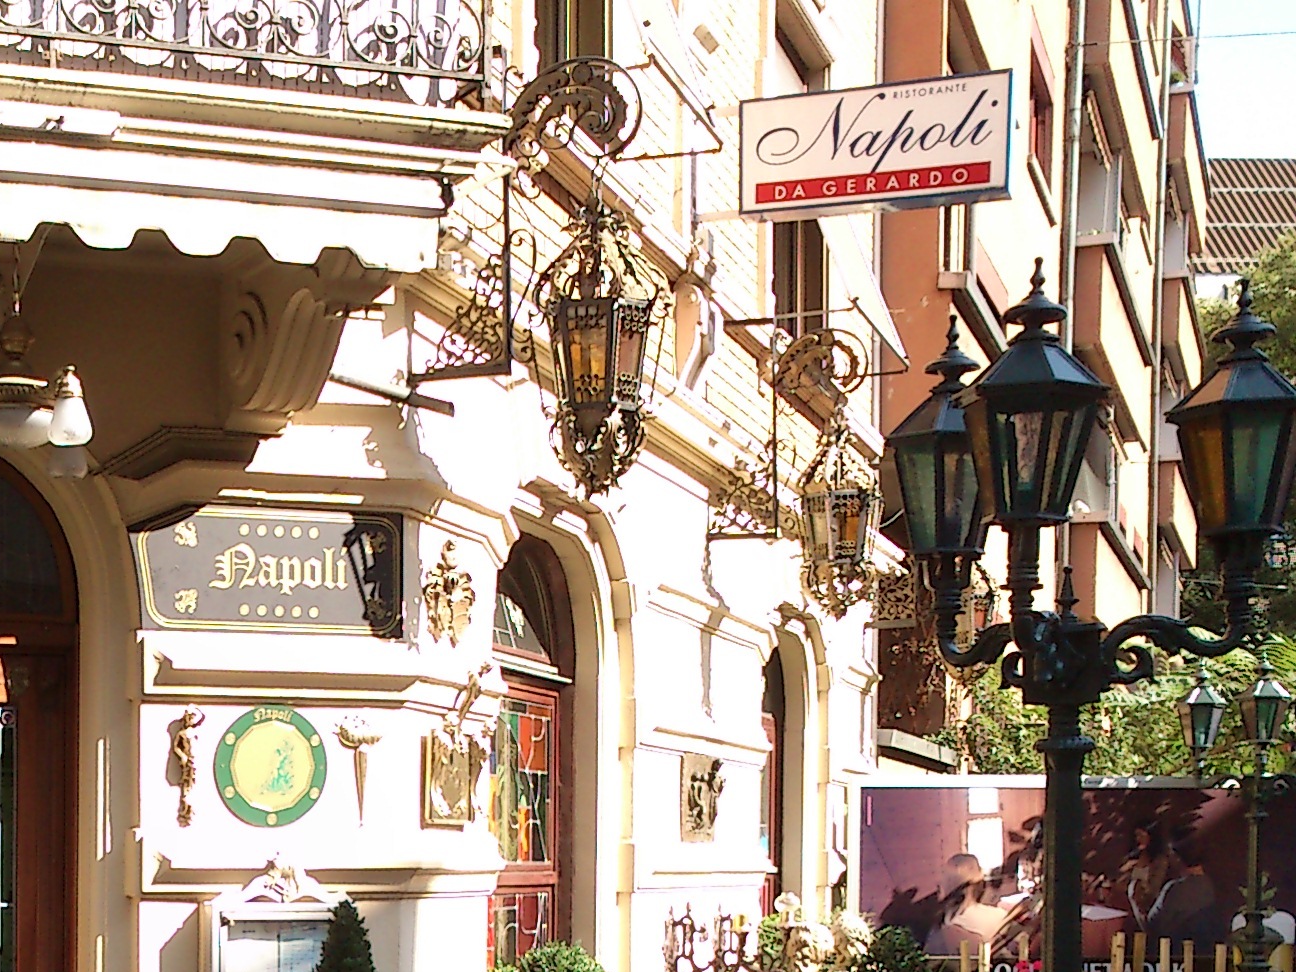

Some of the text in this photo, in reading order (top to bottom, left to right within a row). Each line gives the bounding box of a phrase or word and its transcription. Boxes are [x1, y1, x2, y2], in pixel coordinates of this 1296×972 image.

[892, 83, 967, 99] RISTORANTE
[756, 88, 999, 174] Napoli
[774, 167, 969, 200] DA GERARDO
[208, 542, 349, 596] Napoli
[253, 707, 294, 723] Napoli
